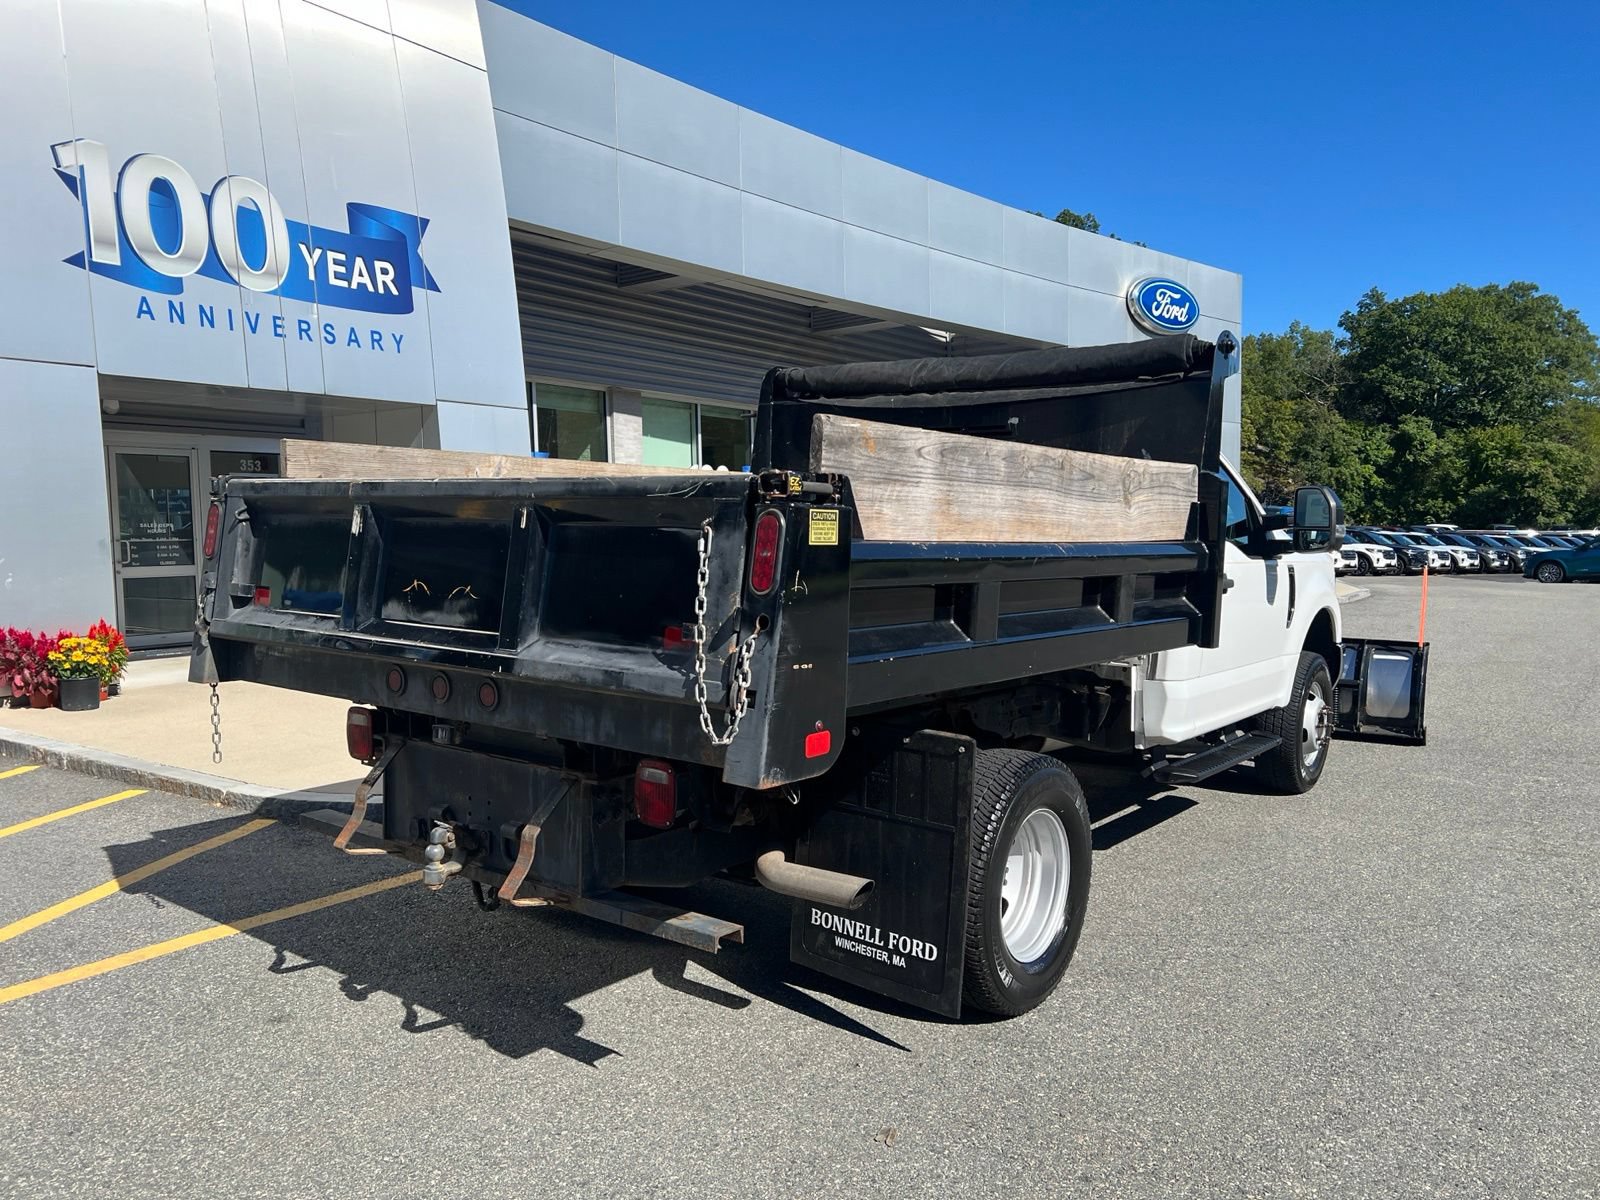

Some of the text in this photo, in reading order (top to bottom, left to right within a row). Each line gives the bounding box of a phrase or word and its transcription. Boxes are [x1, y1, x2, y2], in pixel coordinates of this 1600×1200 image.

[51, 138, 400, 296] 100 YEAR
[1151, 288, 1190, 322] Ford
[135, 295, 405, 354] ANNIVERSARY
[239, 459, 262, 472] 353
[812, 511, 836, 521] CAUTION
[810, 907, 938, 962] BONNELL FORD
[834, 935, 906, 968] WINCHESTER, MA
